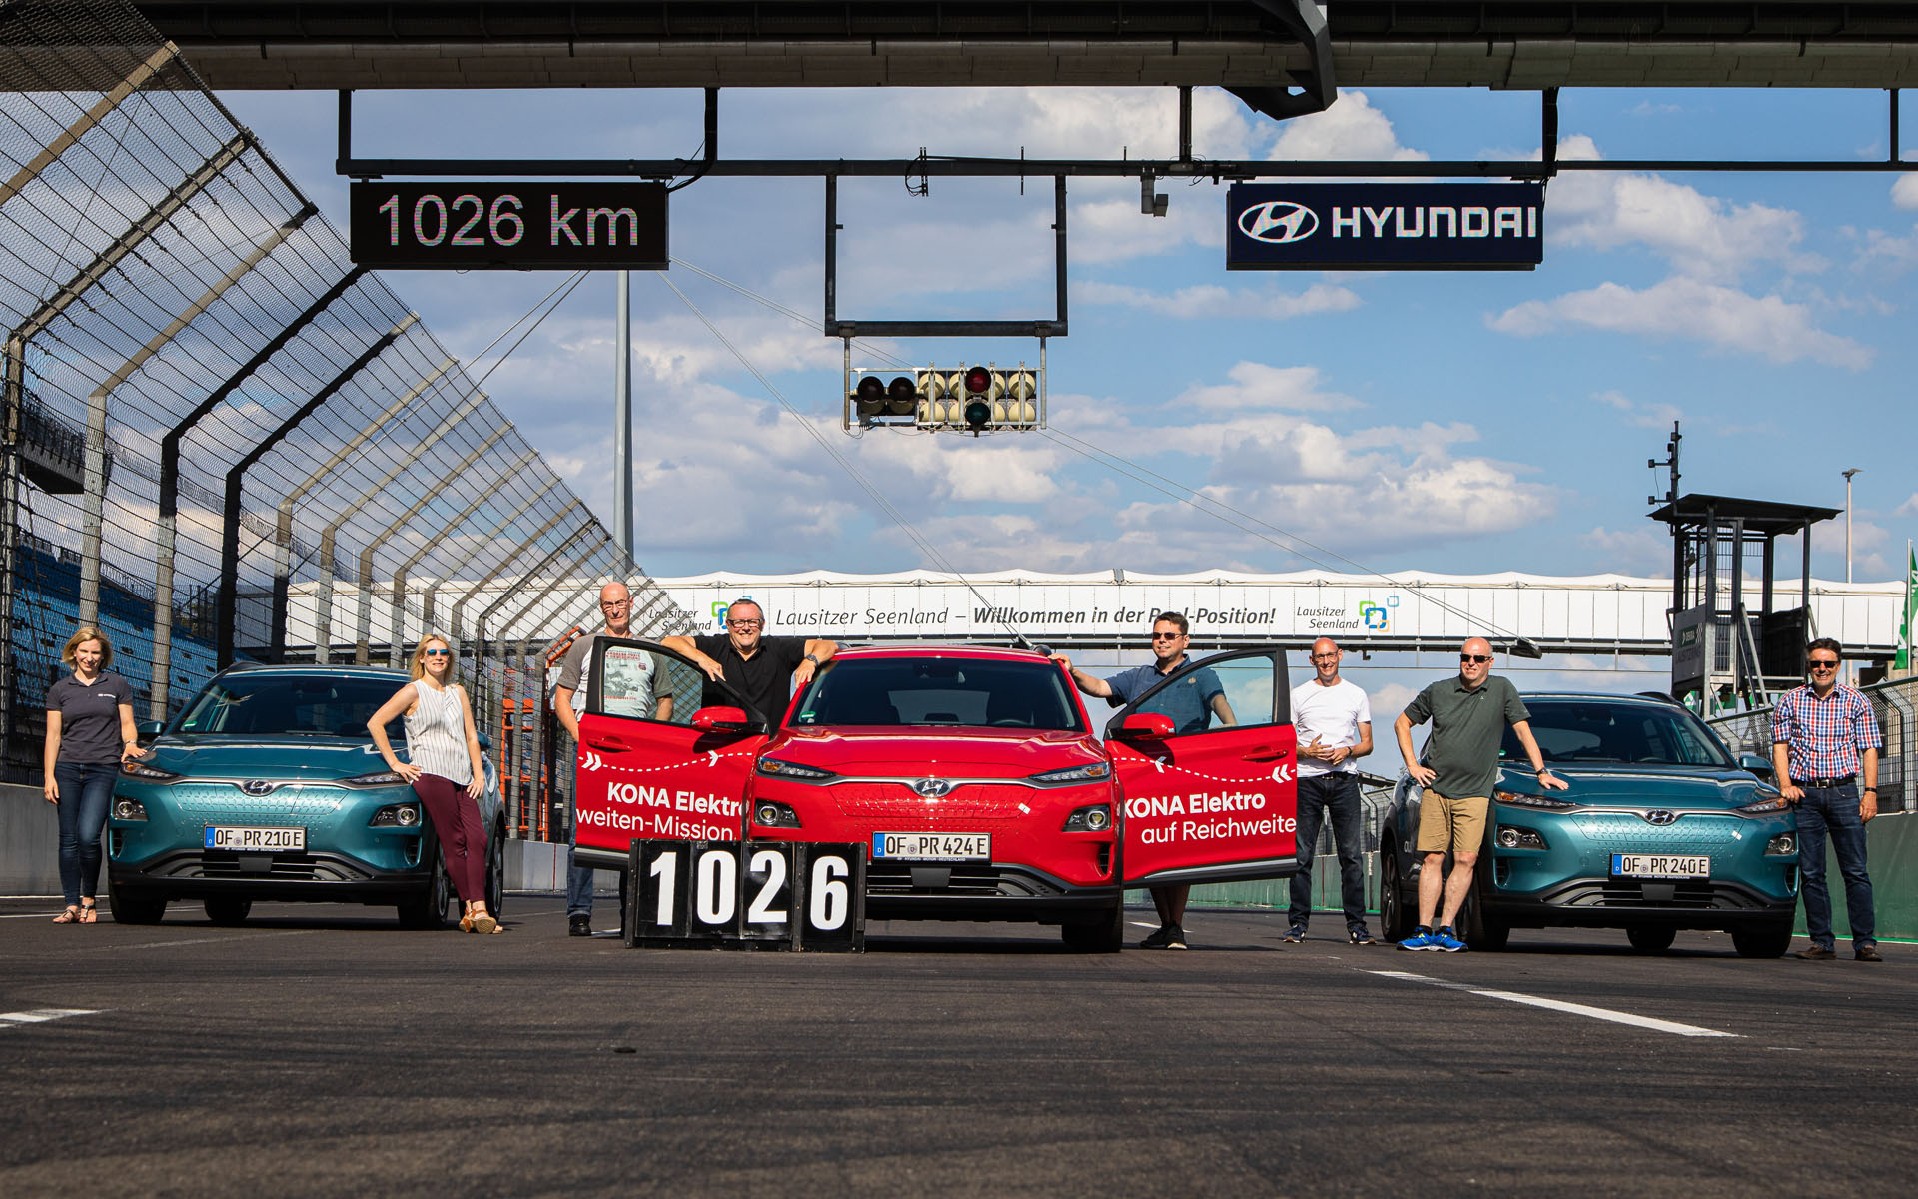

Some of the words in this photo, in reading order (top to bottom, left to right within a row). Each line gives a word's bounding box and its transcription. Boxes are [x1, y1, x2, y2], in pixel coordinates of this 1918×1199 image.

[379, 194, 525, 247] 1026
[550, 194, 638, 246] km
[1332, 206, 1536, 238] HYUNDAI
[649, 608, 699, 619] Lasitzer
[776, 609, 858, 625] Lausitzer
[864, 607, 949, 625] Seenland
[974, 606, 1086, 623] Willkommen
[1091, 606, 1108, 623] in
[1113, 606, 1145, 623] der
[1148, 606, 1277, 624] Pl-Position!
[1296, 606, 1346, 617] Lausitzer
[661, 619, 712, 631] Senland
[1308, 618, 1360, 629] Seenland
[607, 781, 671, 809] KONA
[1189, 791, 1266, 814] Elektro
[575, 806, 734, 841] weiten-Mission
[1141, 821, 1177, 844] auf
[1182, 813, 1297, 841] Reichweite
[215, 829, 234, 845] OF
[886, 836, 907, 854] OF
[919, 837, 939, 855] PR
[1622, 857, 1641, 872] OF
